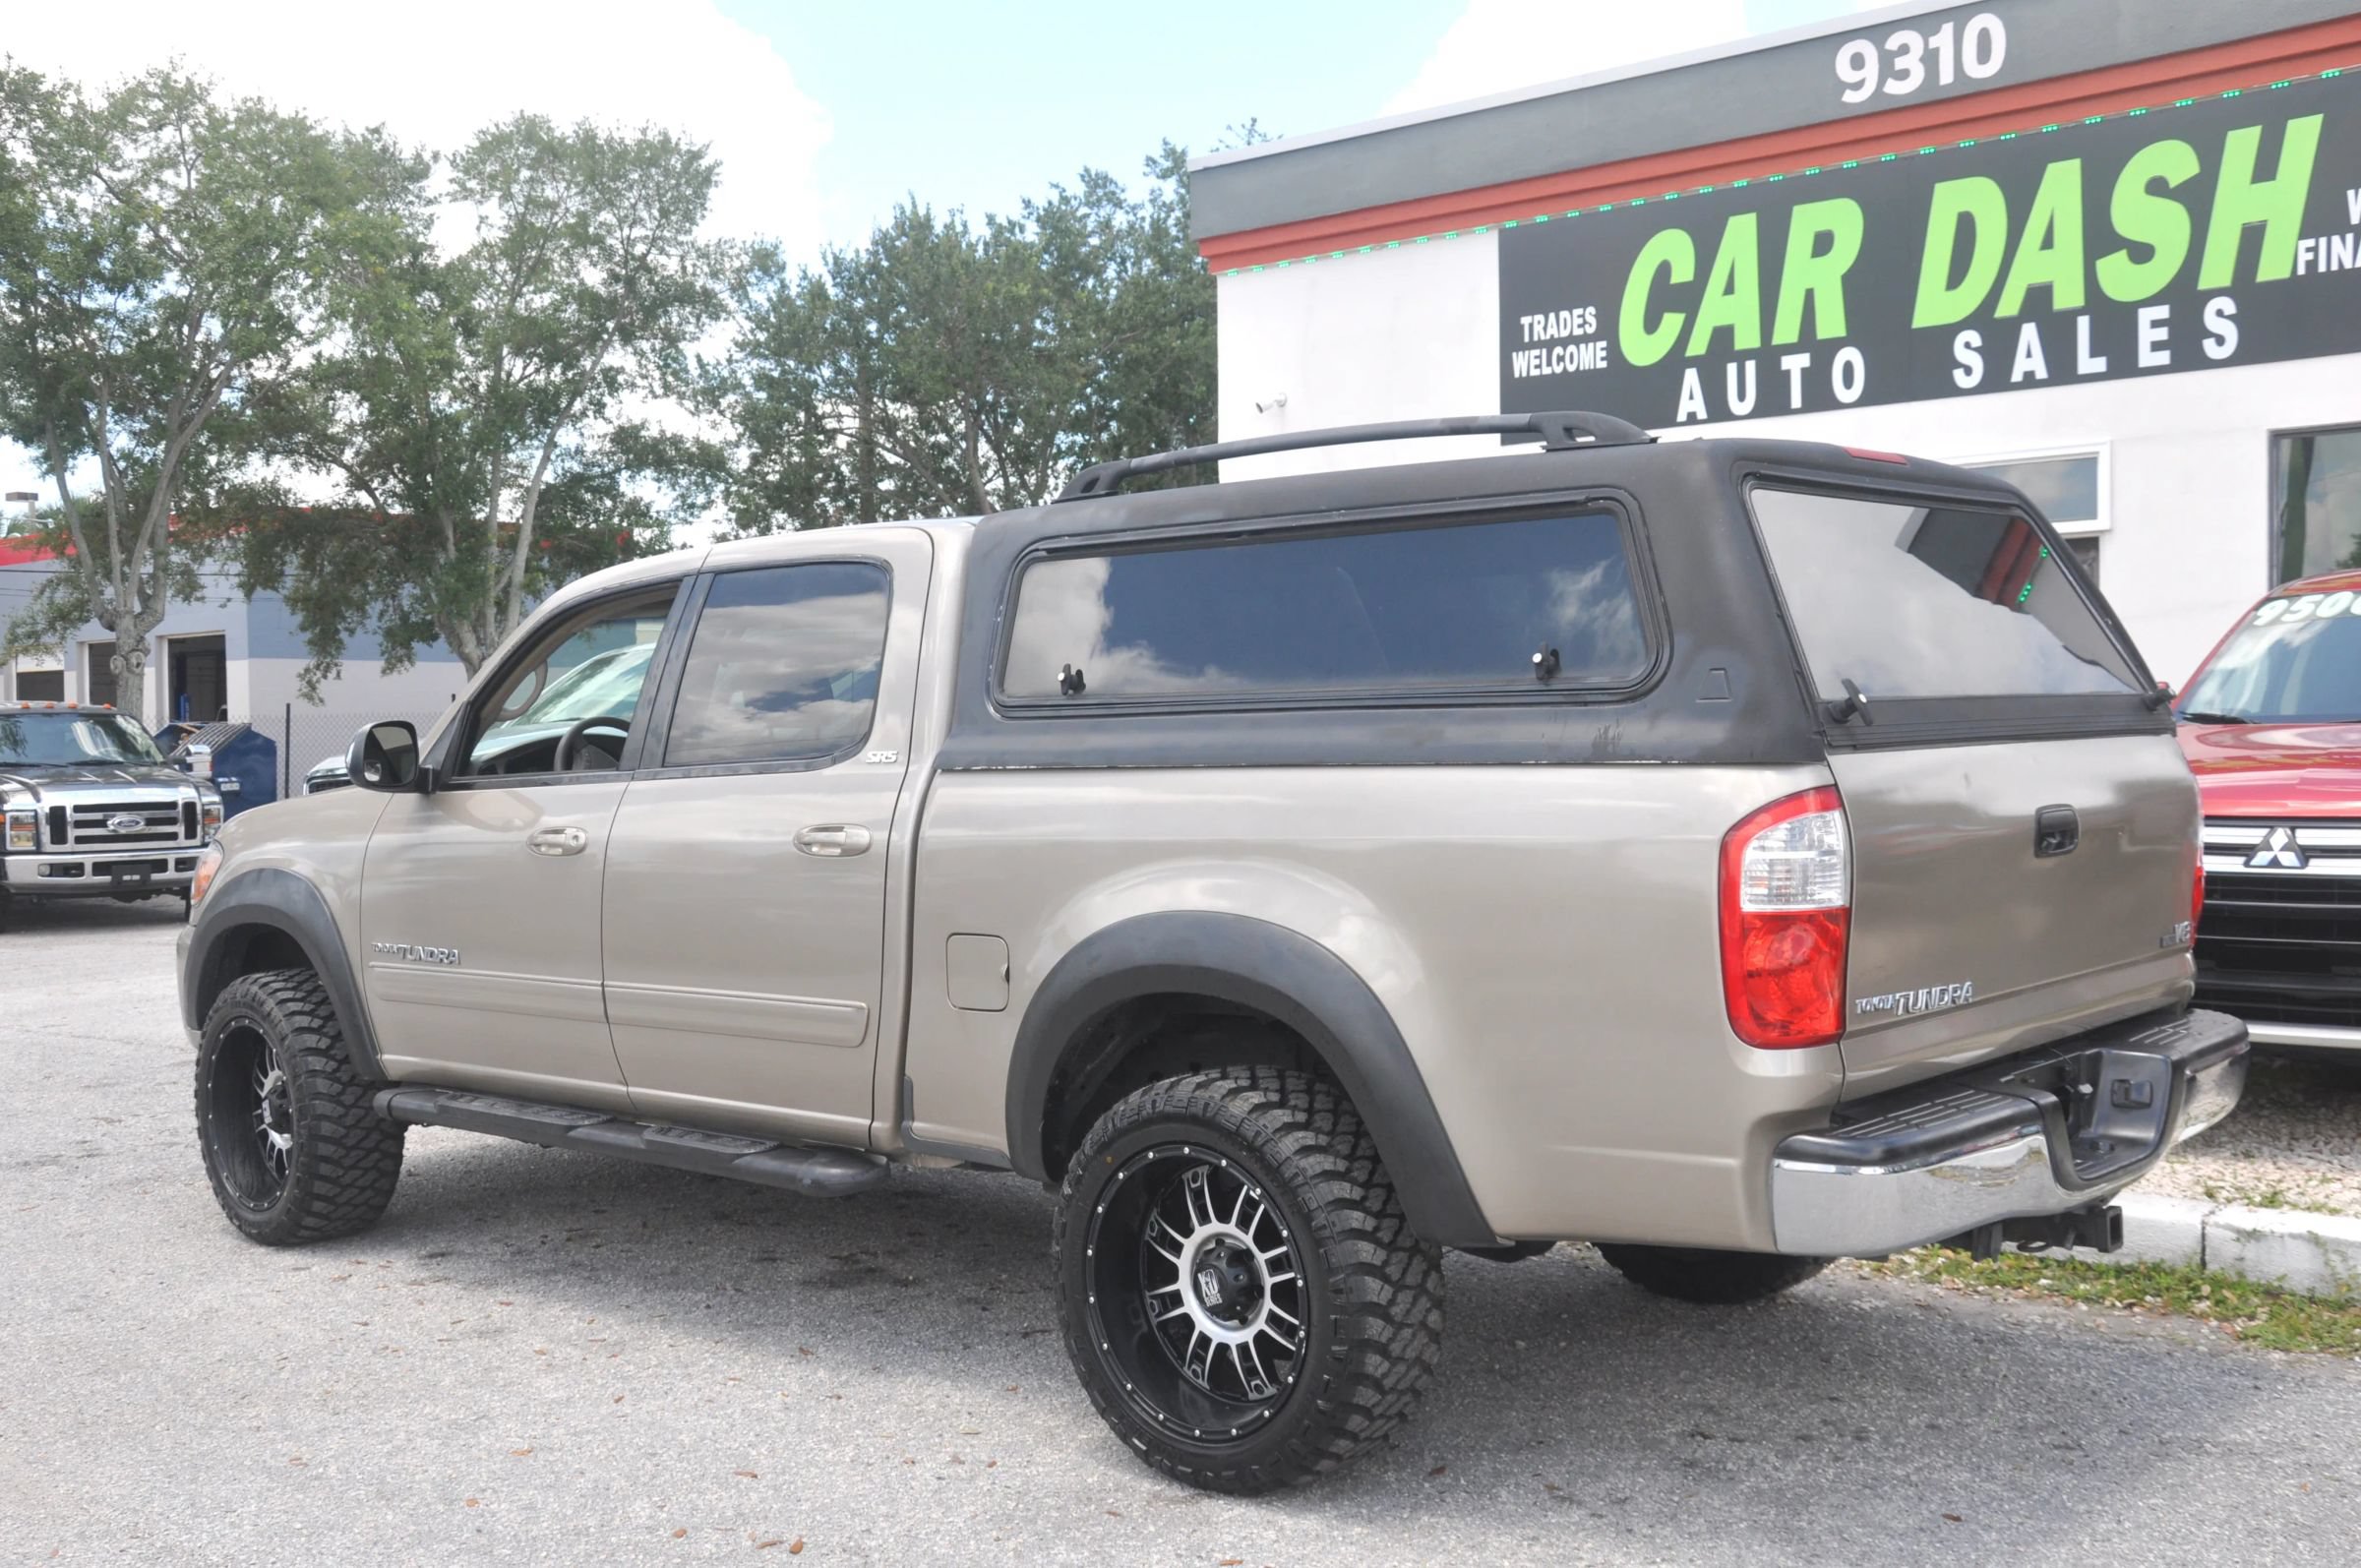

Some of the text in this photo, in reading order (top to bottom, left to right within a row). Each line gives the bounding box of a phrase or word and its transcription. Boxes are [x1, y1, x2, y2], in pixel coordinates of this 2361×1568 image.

[1835, 13, 2008, 104] 9310
[1618, 113, 2324, 367] CAR DASH
[1520, 306, 1598, 343] TRADES
[1512, 340, 1608, 379] WELCOME
[1676, 295, 2240, 423] AUTO SALES
[866, 750, 898, 763] SR5
[397, 943, 461, 965] TUNDRA
[1894, 982, 1972, 1016] TUNDRA
